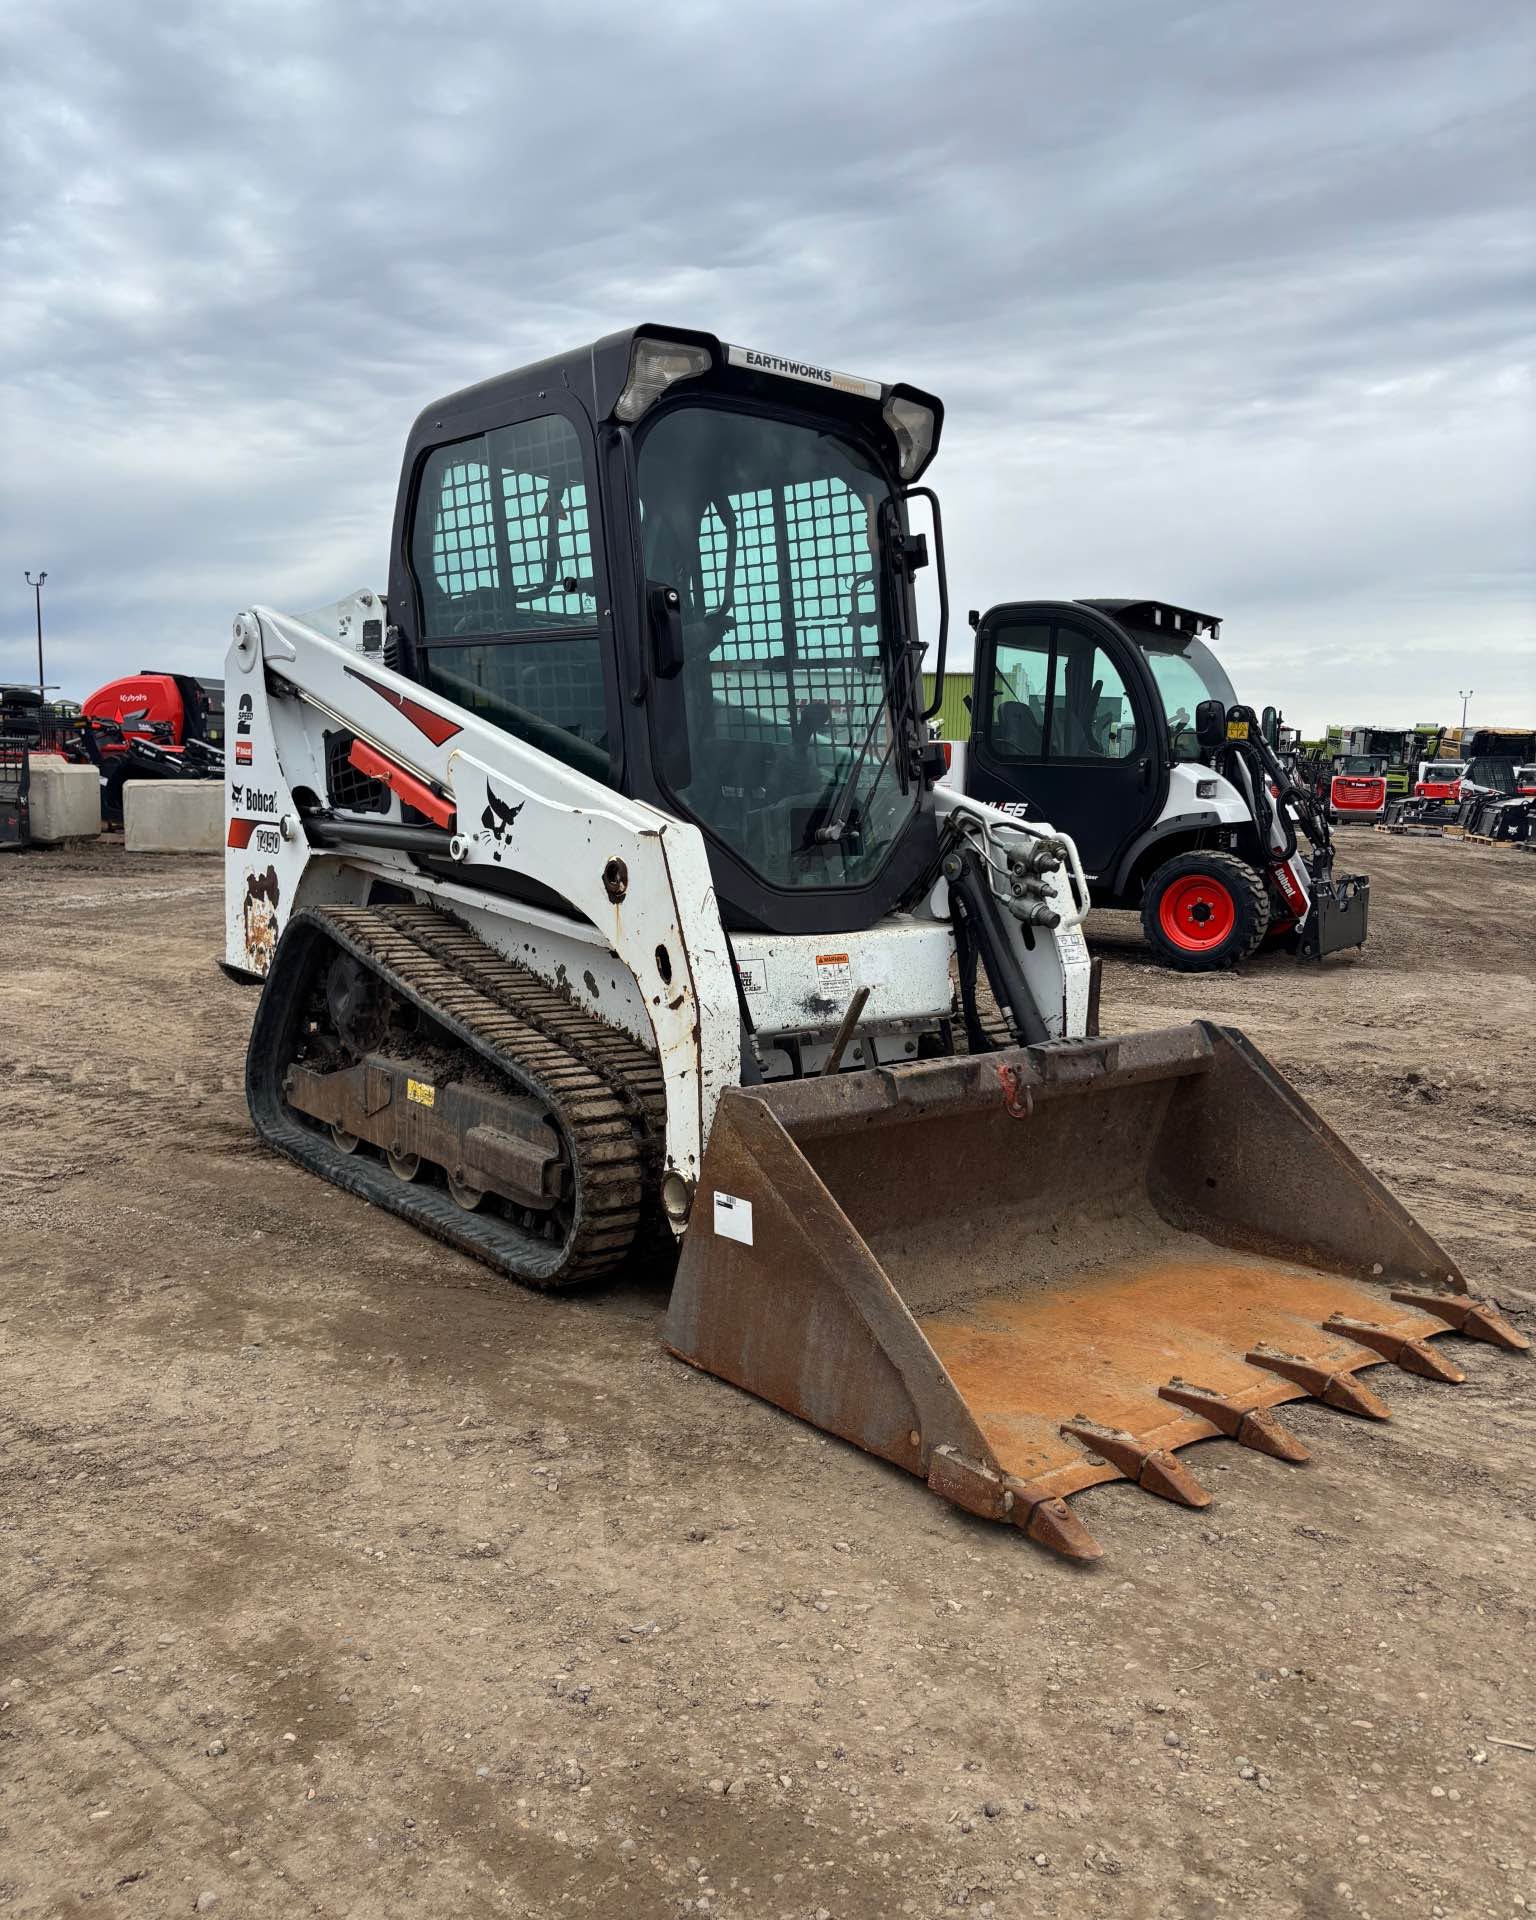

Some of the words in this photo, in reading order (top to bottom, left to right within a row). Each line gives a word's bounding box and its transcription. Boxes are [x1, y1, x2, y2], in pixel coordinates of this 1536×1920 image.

[746, 351, 832, 382] EARTHWORKS
[238, 711, 253, 720] SPEED
[256, 830, 280, 854] T450
[1275, 868, 1296, 897] Bobcat
